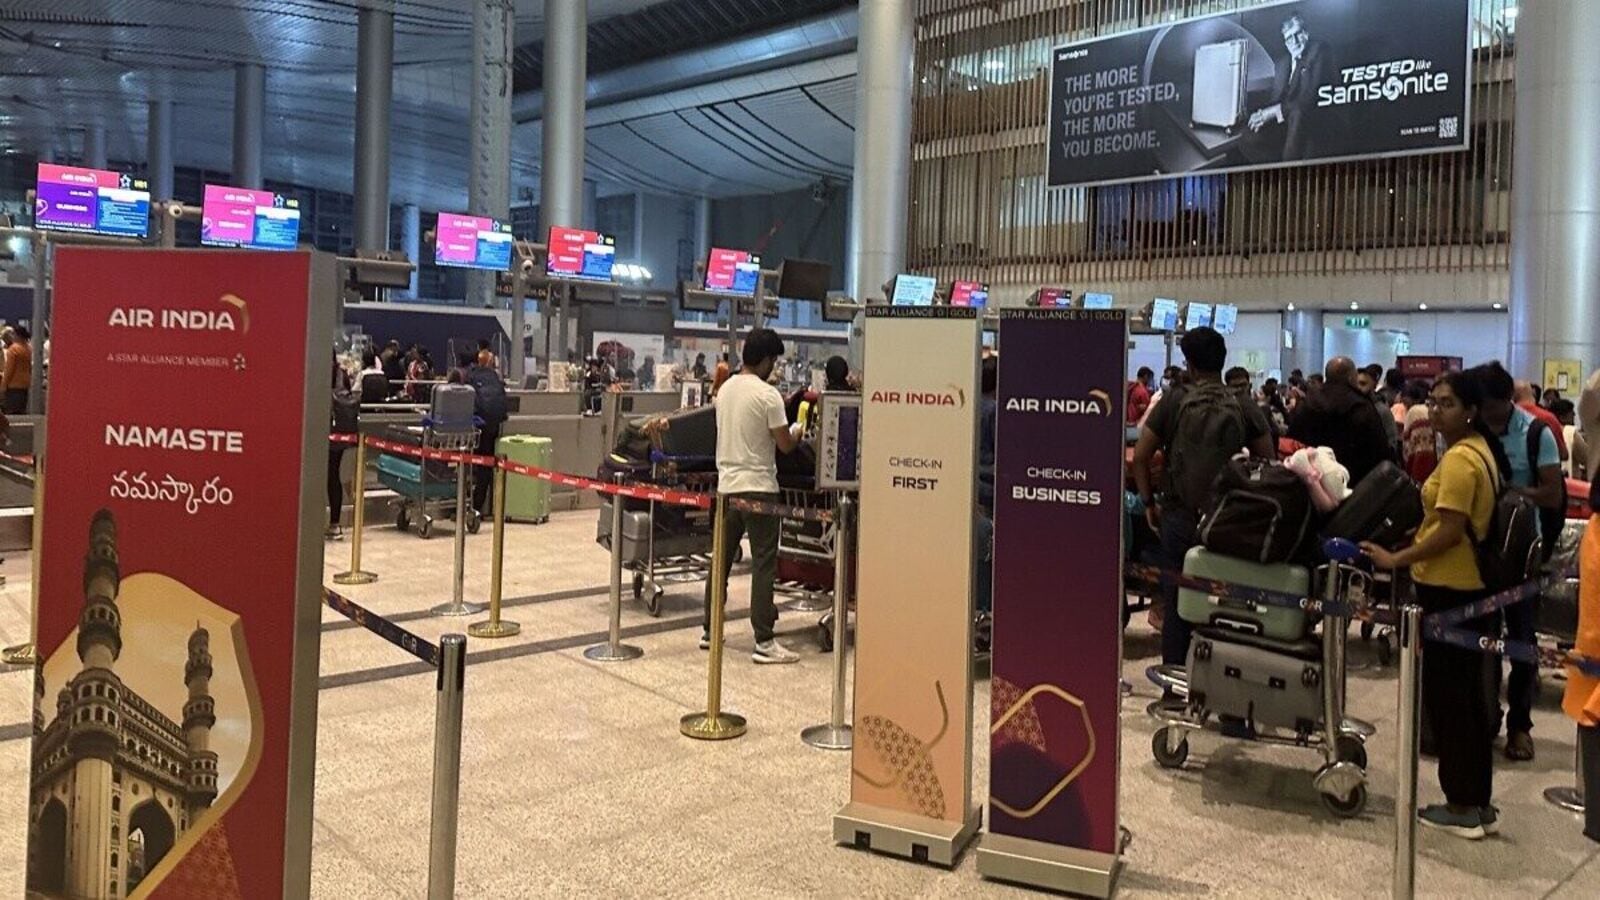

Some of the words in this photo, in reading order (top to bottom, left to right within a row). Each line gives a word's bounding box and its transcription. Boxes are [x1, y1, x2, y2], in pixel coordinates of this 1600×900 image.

[1064, 73, 1091, 94] THE
[1095, 65, 1138, 89] MORE
[1341, 59, 1415, 83] TESTED
[1064, 91, 1114, 115] YOU'RE
[1118, 82, 1180, 107] TESTED,
[1317, 72, 1449, 107] Samsonite
[1063, 118, 1089, 136] THE
[1093, 111, 1136, 132] MORE
[1062, 140, 1090, 158] YOU
[1094, 130, 1161, 155] BECOME.
[108, 308, 154, 328] AIR
[161, 309, 236, 331] INDIA
[866, 307, 889, 317] STAR
[890, 308, 933, 318] ALLIANCE
[950, 308, 976, 318] GOLD
[999, 309, 1025, 320] STAR
[1027, 310, 1075, 320] ALLIANCE
[1095, 310, 1123, 320] GOLD
[107, 352, 114, 361] A
[115, 353, 138, 362] STAR
[141, 354, 184, 365] ALLIANCE
[186, 356, 229, 367] MEMBER
[871, 391, 900, 404] AIR
[906, 392, 955, 406] INDIA
[1006, 398, 1040, 412] AIR
[1045, 399, 1101, 415] INDIA
[105, 424, 244, 453] NAMASTE
[888, 456, 943, 470] CHECK-IN
[1027, 467, 1087, 480] CHECK-IN
[110, 470, 233, 514] నమస్కారం
[892, 476, 939, 490] FIRST
[1012, 486, 1101, 505] BUSINESS
